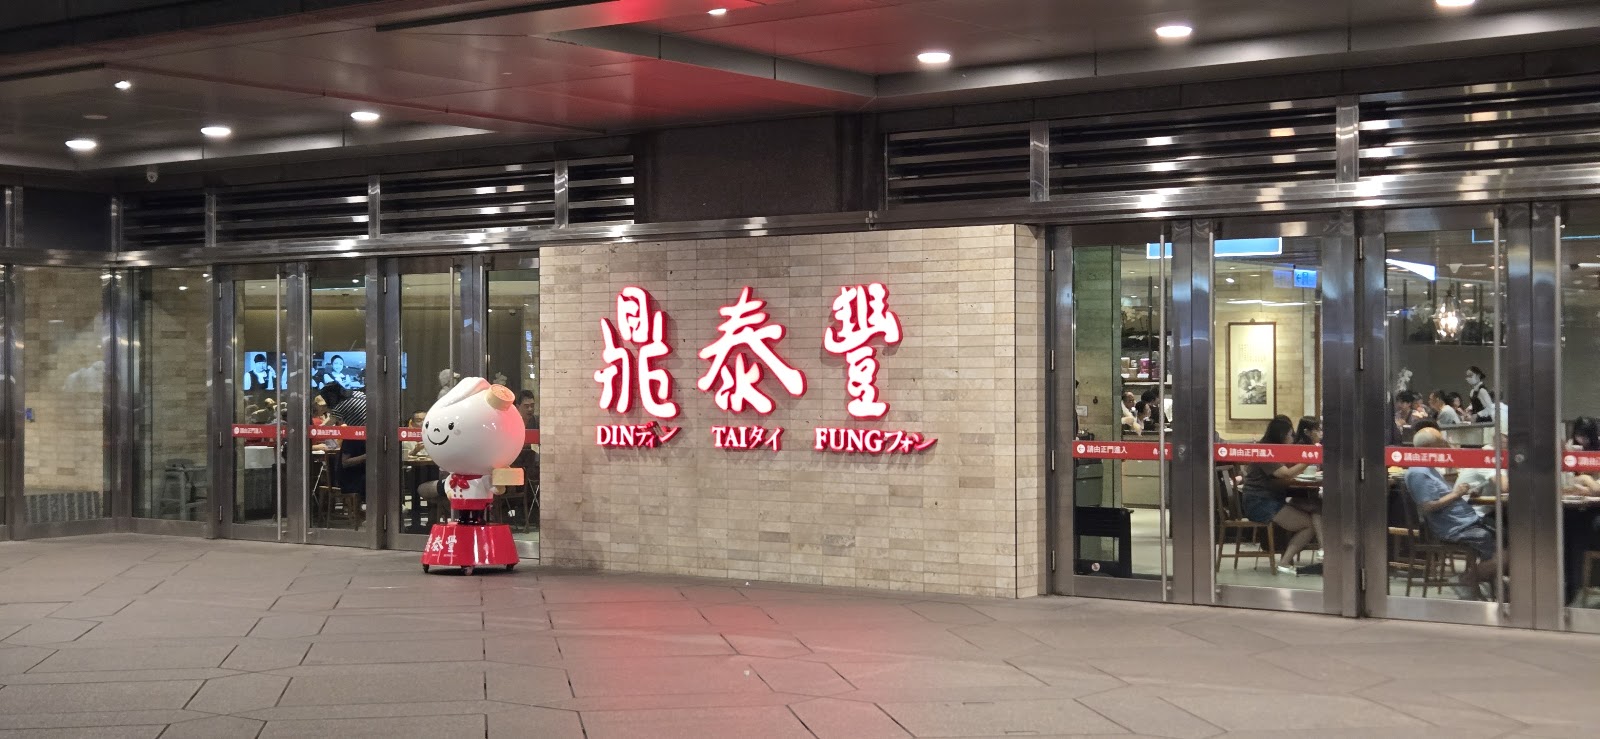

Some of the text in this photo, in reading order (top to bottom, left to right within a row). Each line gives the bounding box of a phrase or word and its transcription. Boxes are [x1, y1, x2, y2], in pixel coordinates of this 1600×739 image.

[594, 283, 902, 418] 鼎泰豐
[711, 424, 782, 451] TAIタイ
[815, 427, 938, 453] FUNGフォン
